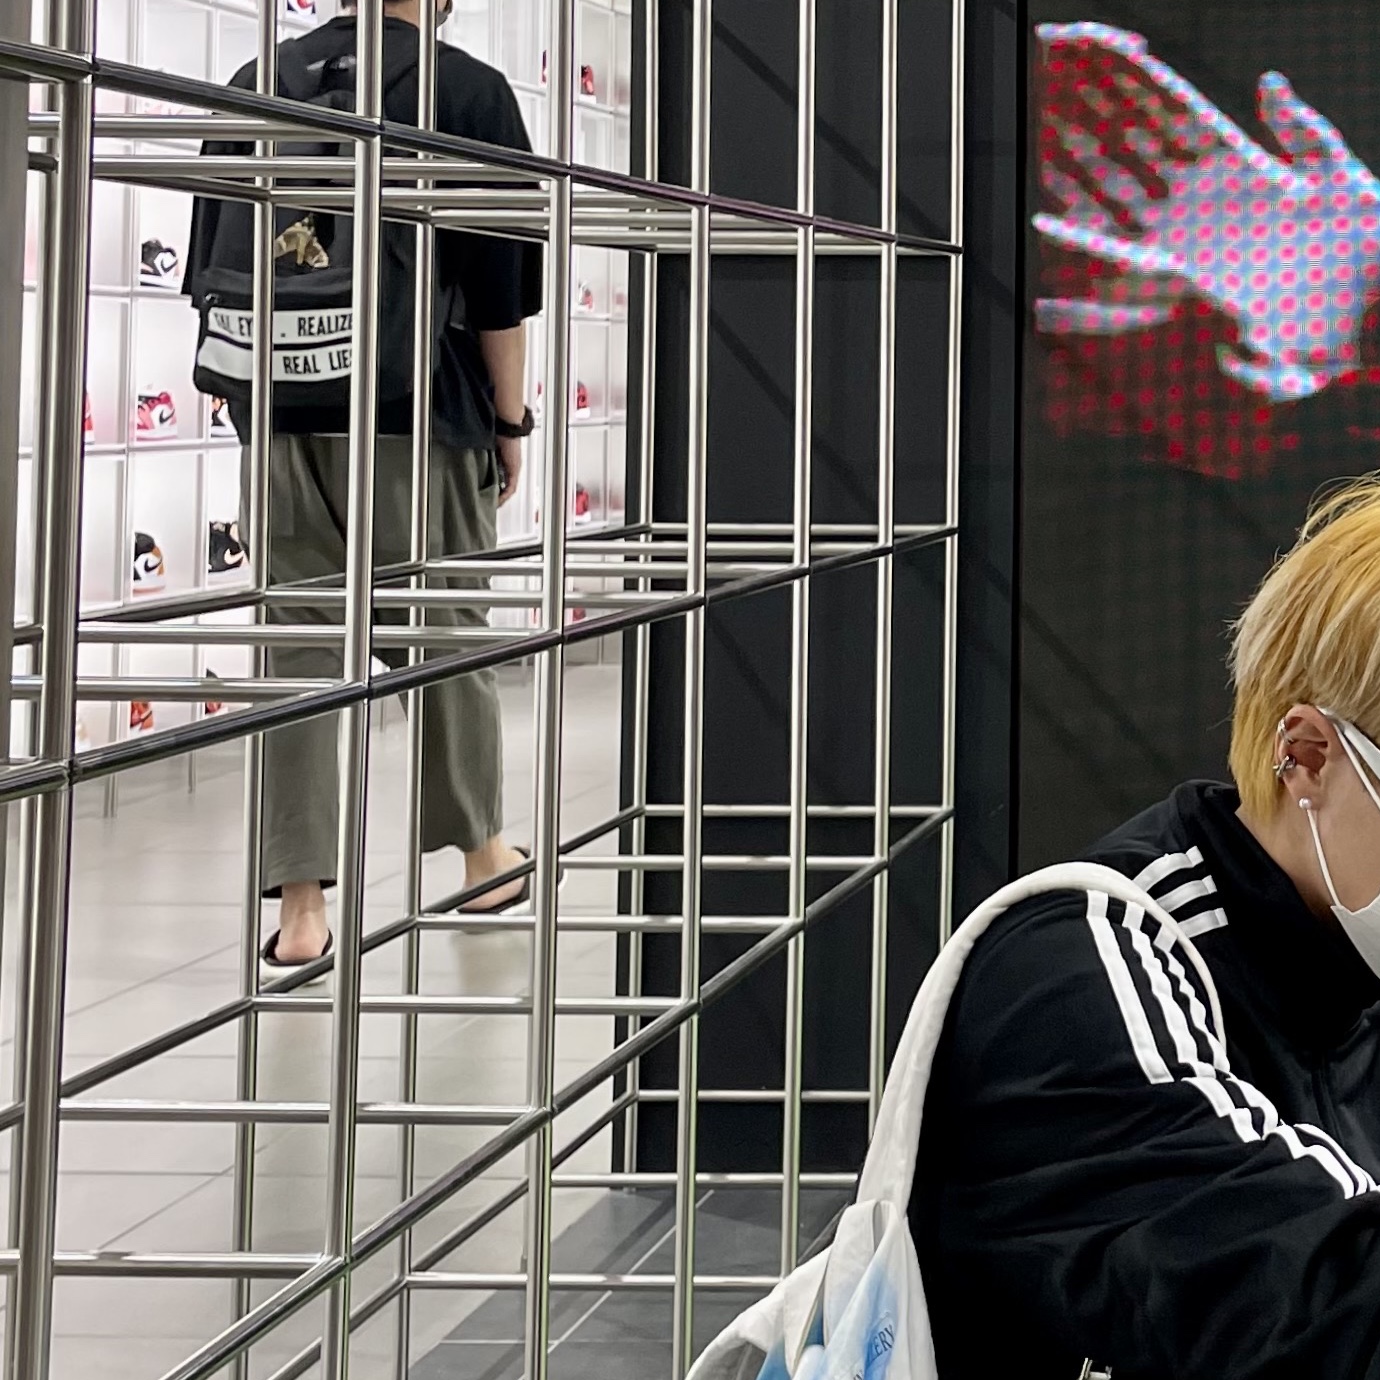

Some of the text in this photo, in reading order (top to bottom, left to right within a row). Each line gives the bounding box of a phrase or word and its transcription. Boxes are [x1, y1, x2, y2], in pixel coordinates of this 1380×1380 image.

[283, 349, 352, 374] REAL LIE
[875, 1324, 895, 1357] ERY
